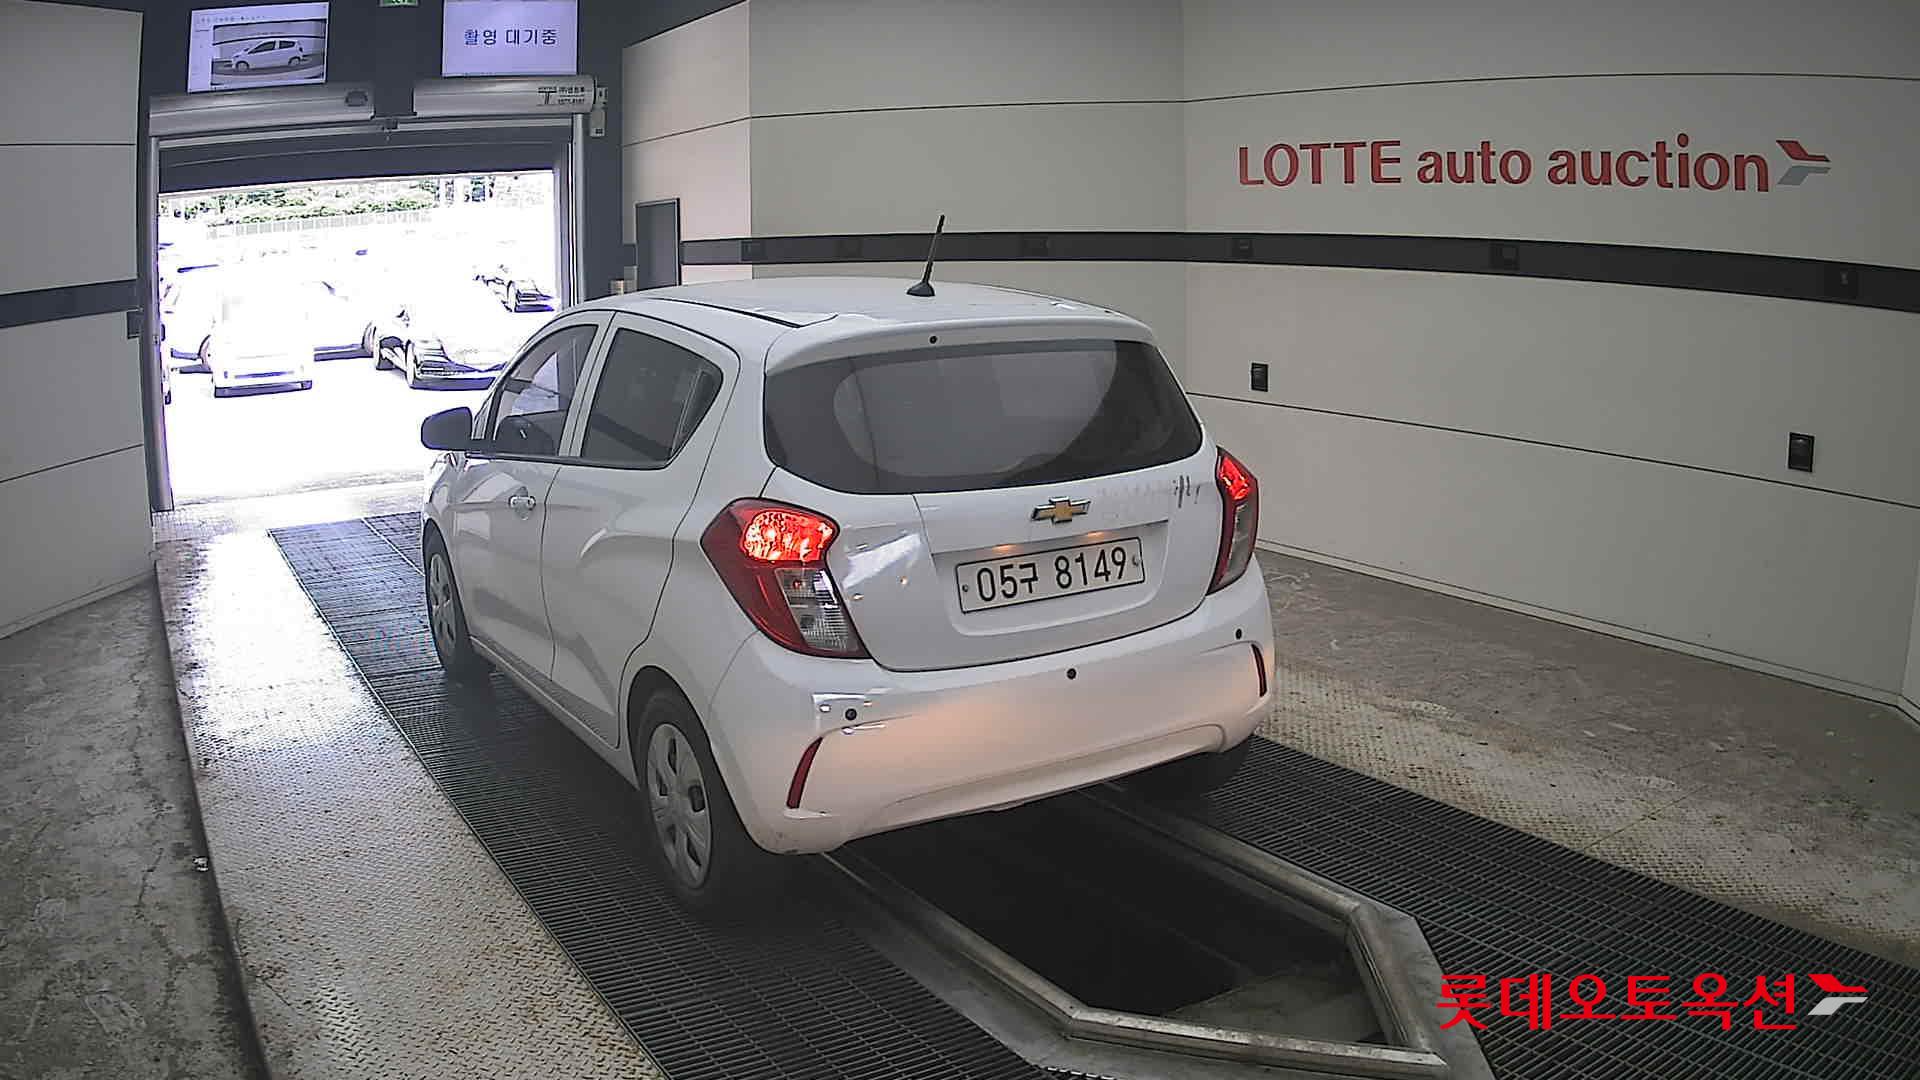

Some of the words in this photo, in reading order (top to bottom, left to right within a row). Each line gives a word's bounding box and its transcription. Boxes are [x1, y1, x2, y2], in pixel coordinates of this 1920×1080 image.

[464, 29, 498, 46] 촬영
[504, 28, 558, 46] 대기중
[1238, 139, 1401, 187] LOTTE
[1416, 140, 1533, 185] auto
[1546, 133, 1770, 193] auction
[976, 562, 1039, 603] 05구
[1054, 545, 1128, 590] 8149
